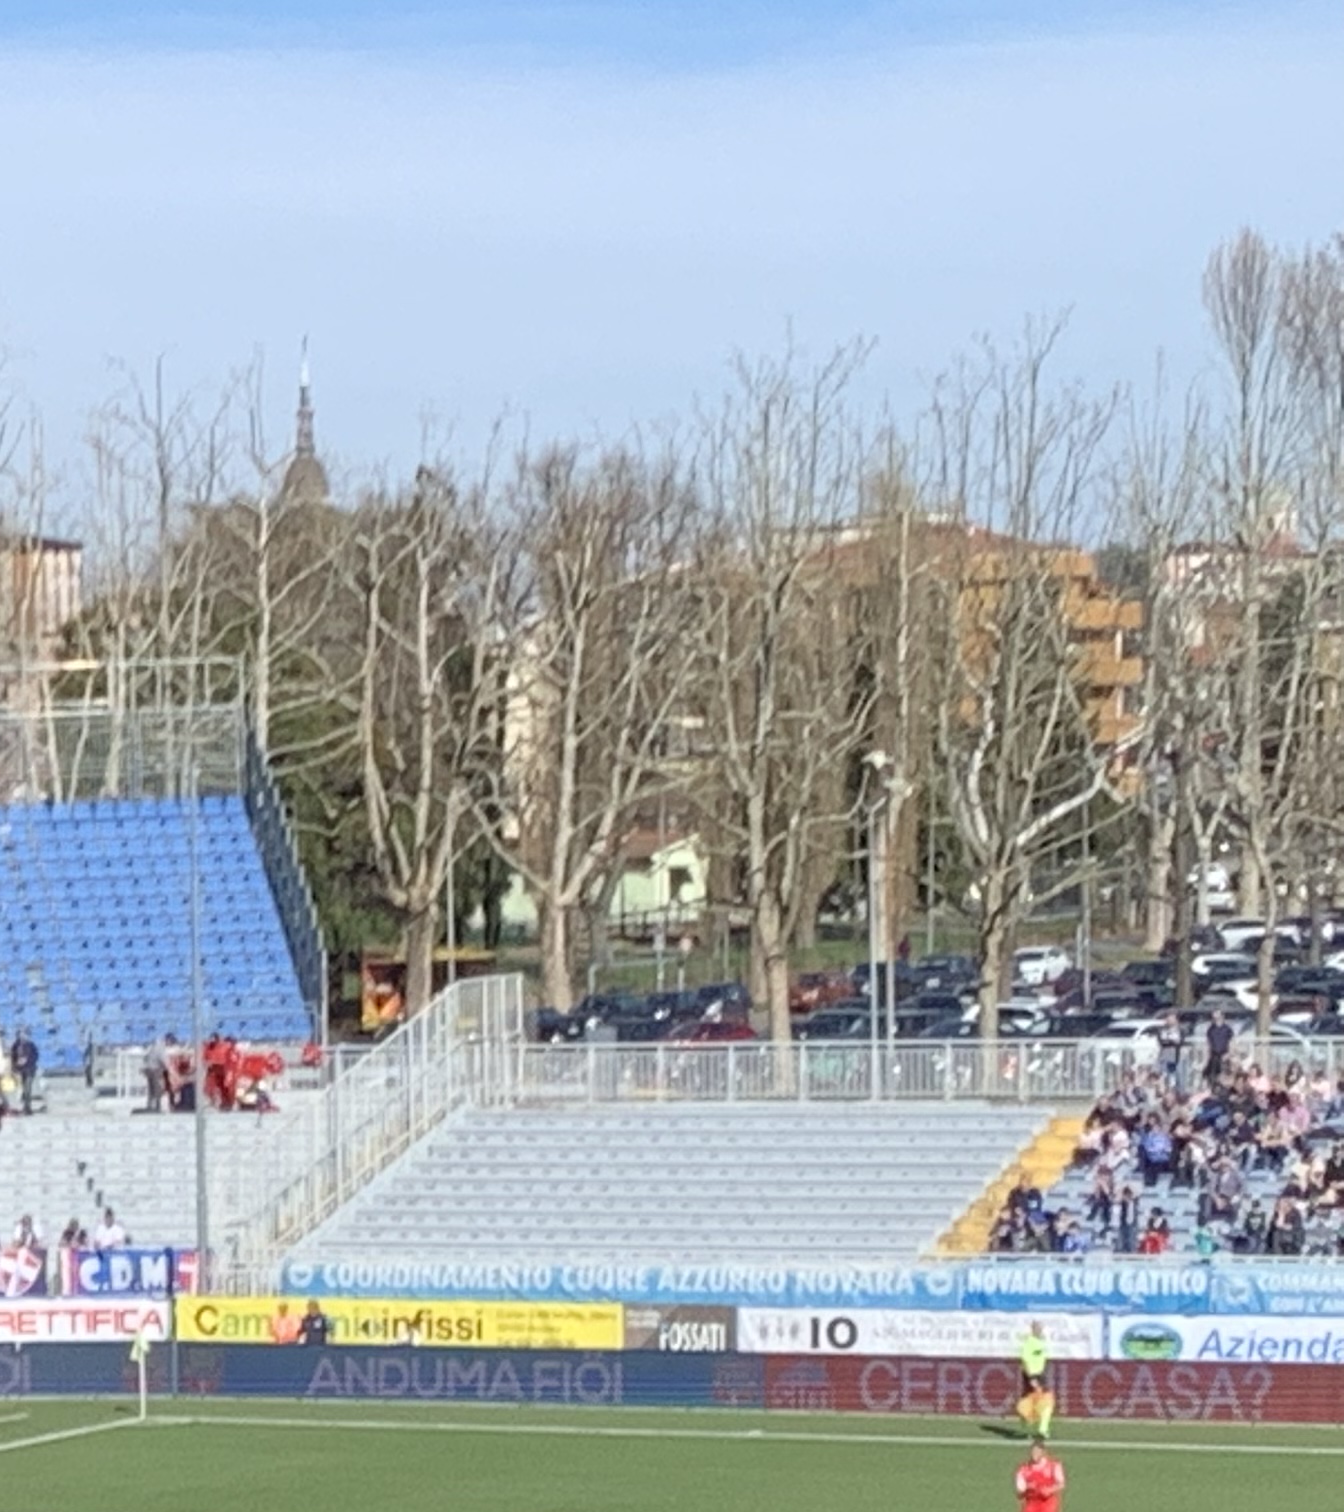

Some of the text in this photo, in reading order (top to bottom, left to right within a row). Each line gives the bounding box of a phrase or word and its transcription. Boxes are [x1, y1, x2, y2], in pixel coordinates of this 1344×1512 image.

[322, 1263, 914, 1296] COORDINAMENTO CUORE AZZURRO NOVARA
[968, 1267, 1056, 1294] NOVARA
[1118, 1269, 1208, 1297] GATTICO
[659, 1322, 727, 1351] FOSSATI
[305, 1356, 524, 1399] ANDUMA
[861, 1359, 1068, 1415] CERCI
[1081, 1363, 1273, 1419] CASA?
